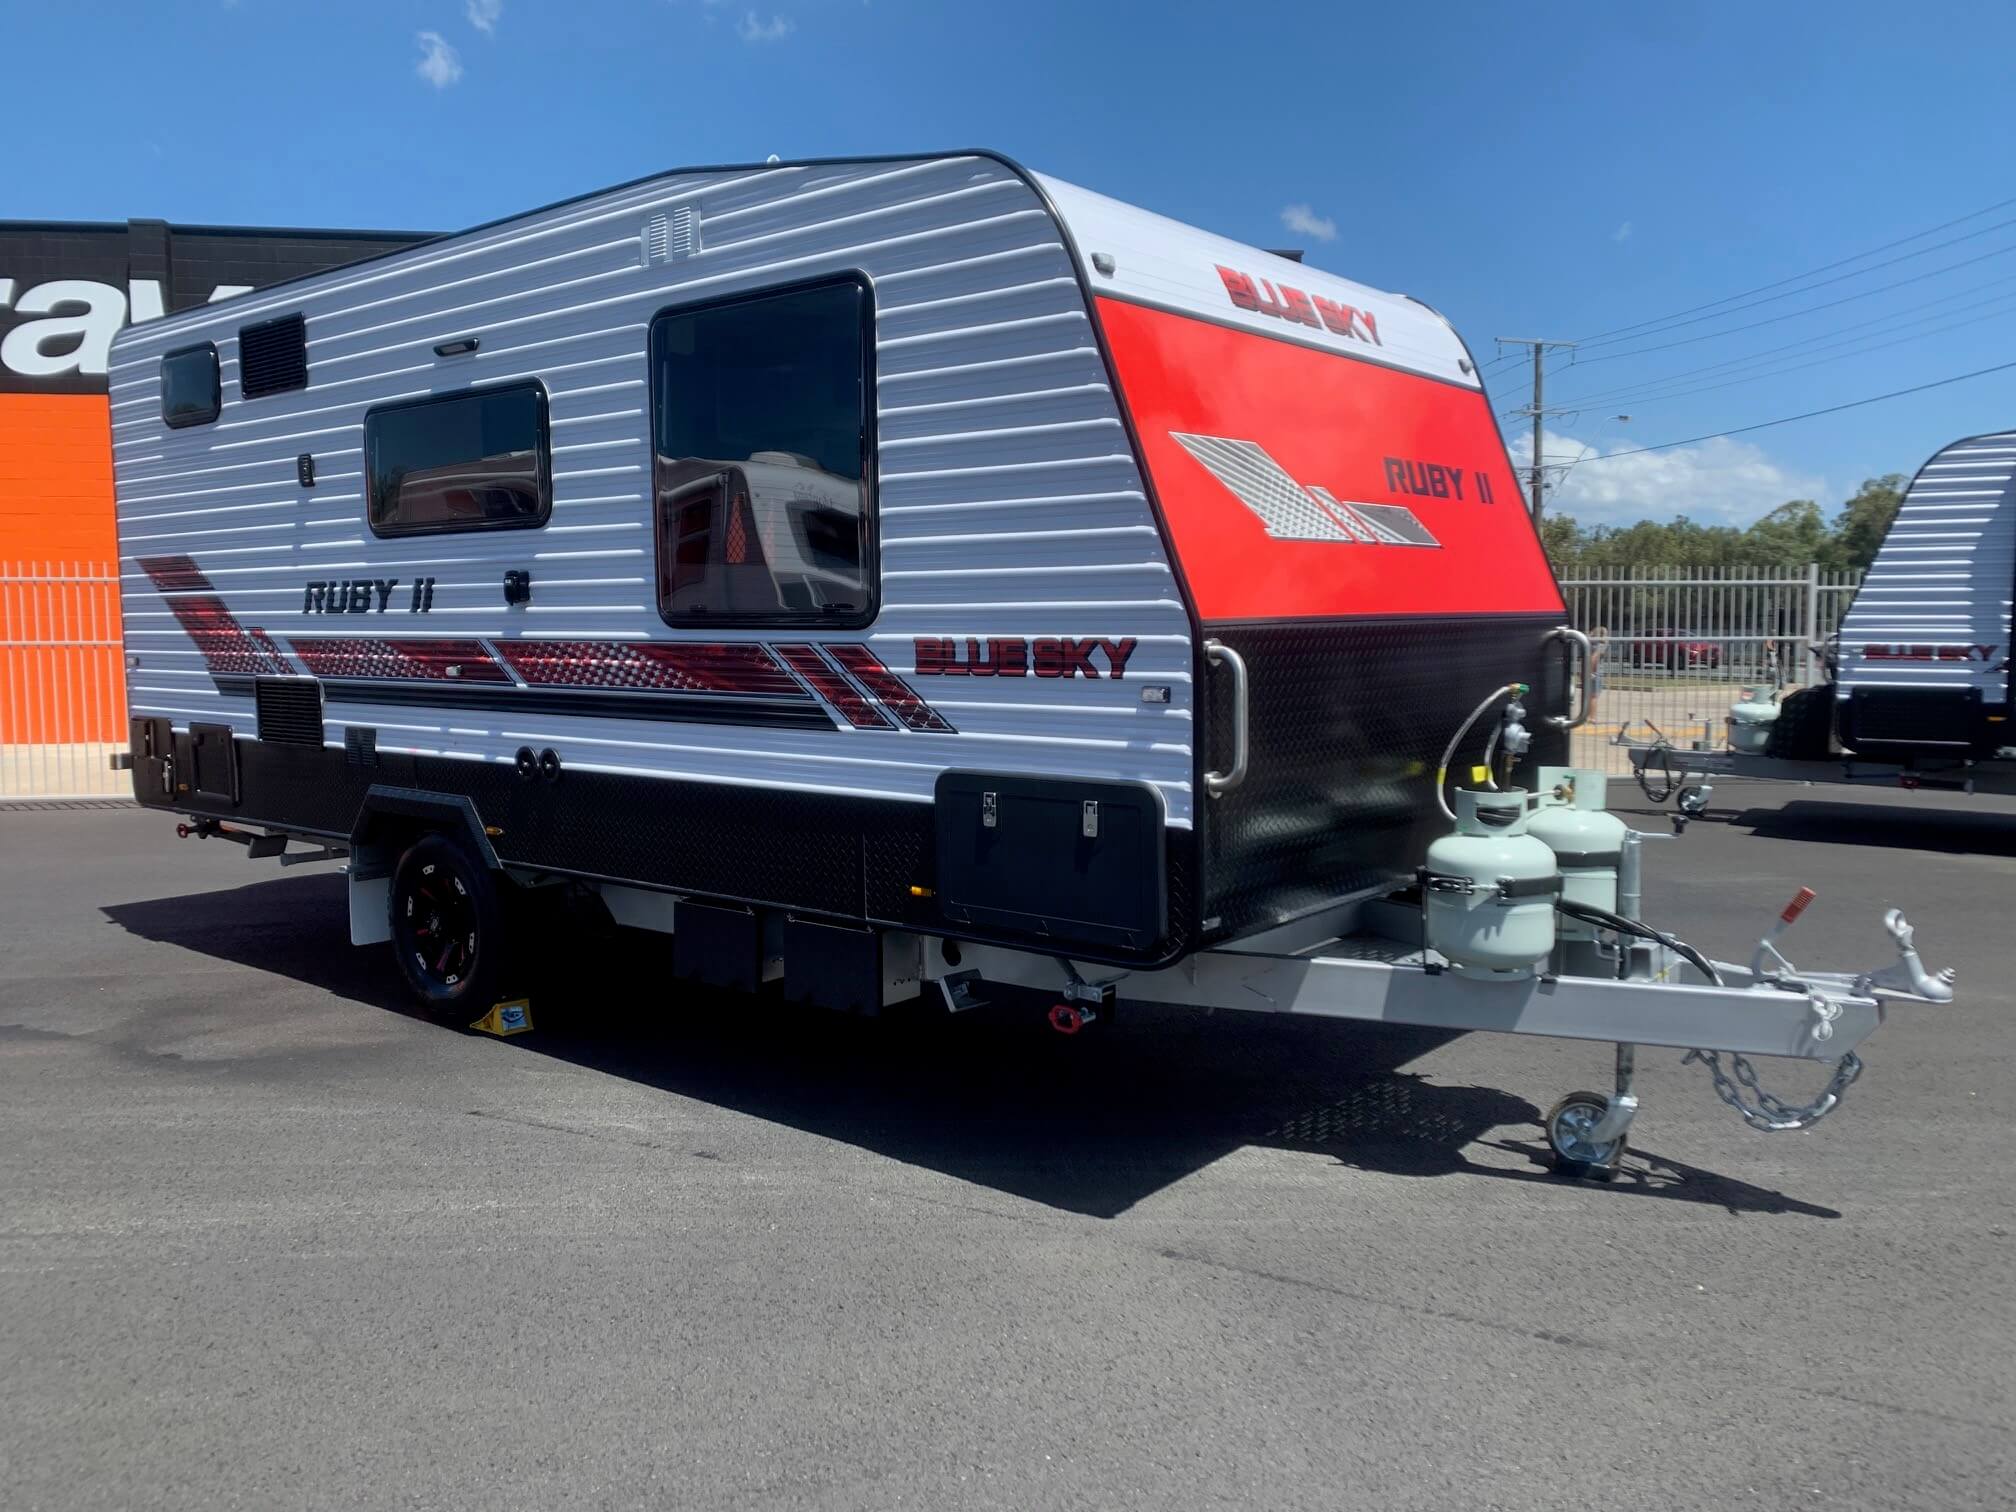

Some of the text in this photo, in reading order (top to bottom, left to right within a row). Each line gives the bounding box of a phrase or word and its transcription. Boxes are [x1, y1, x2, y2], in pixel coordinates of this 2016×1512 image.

[1383, 456, 1494, 504] RUBY II
[302, 576, 435, 614] RUBY II
